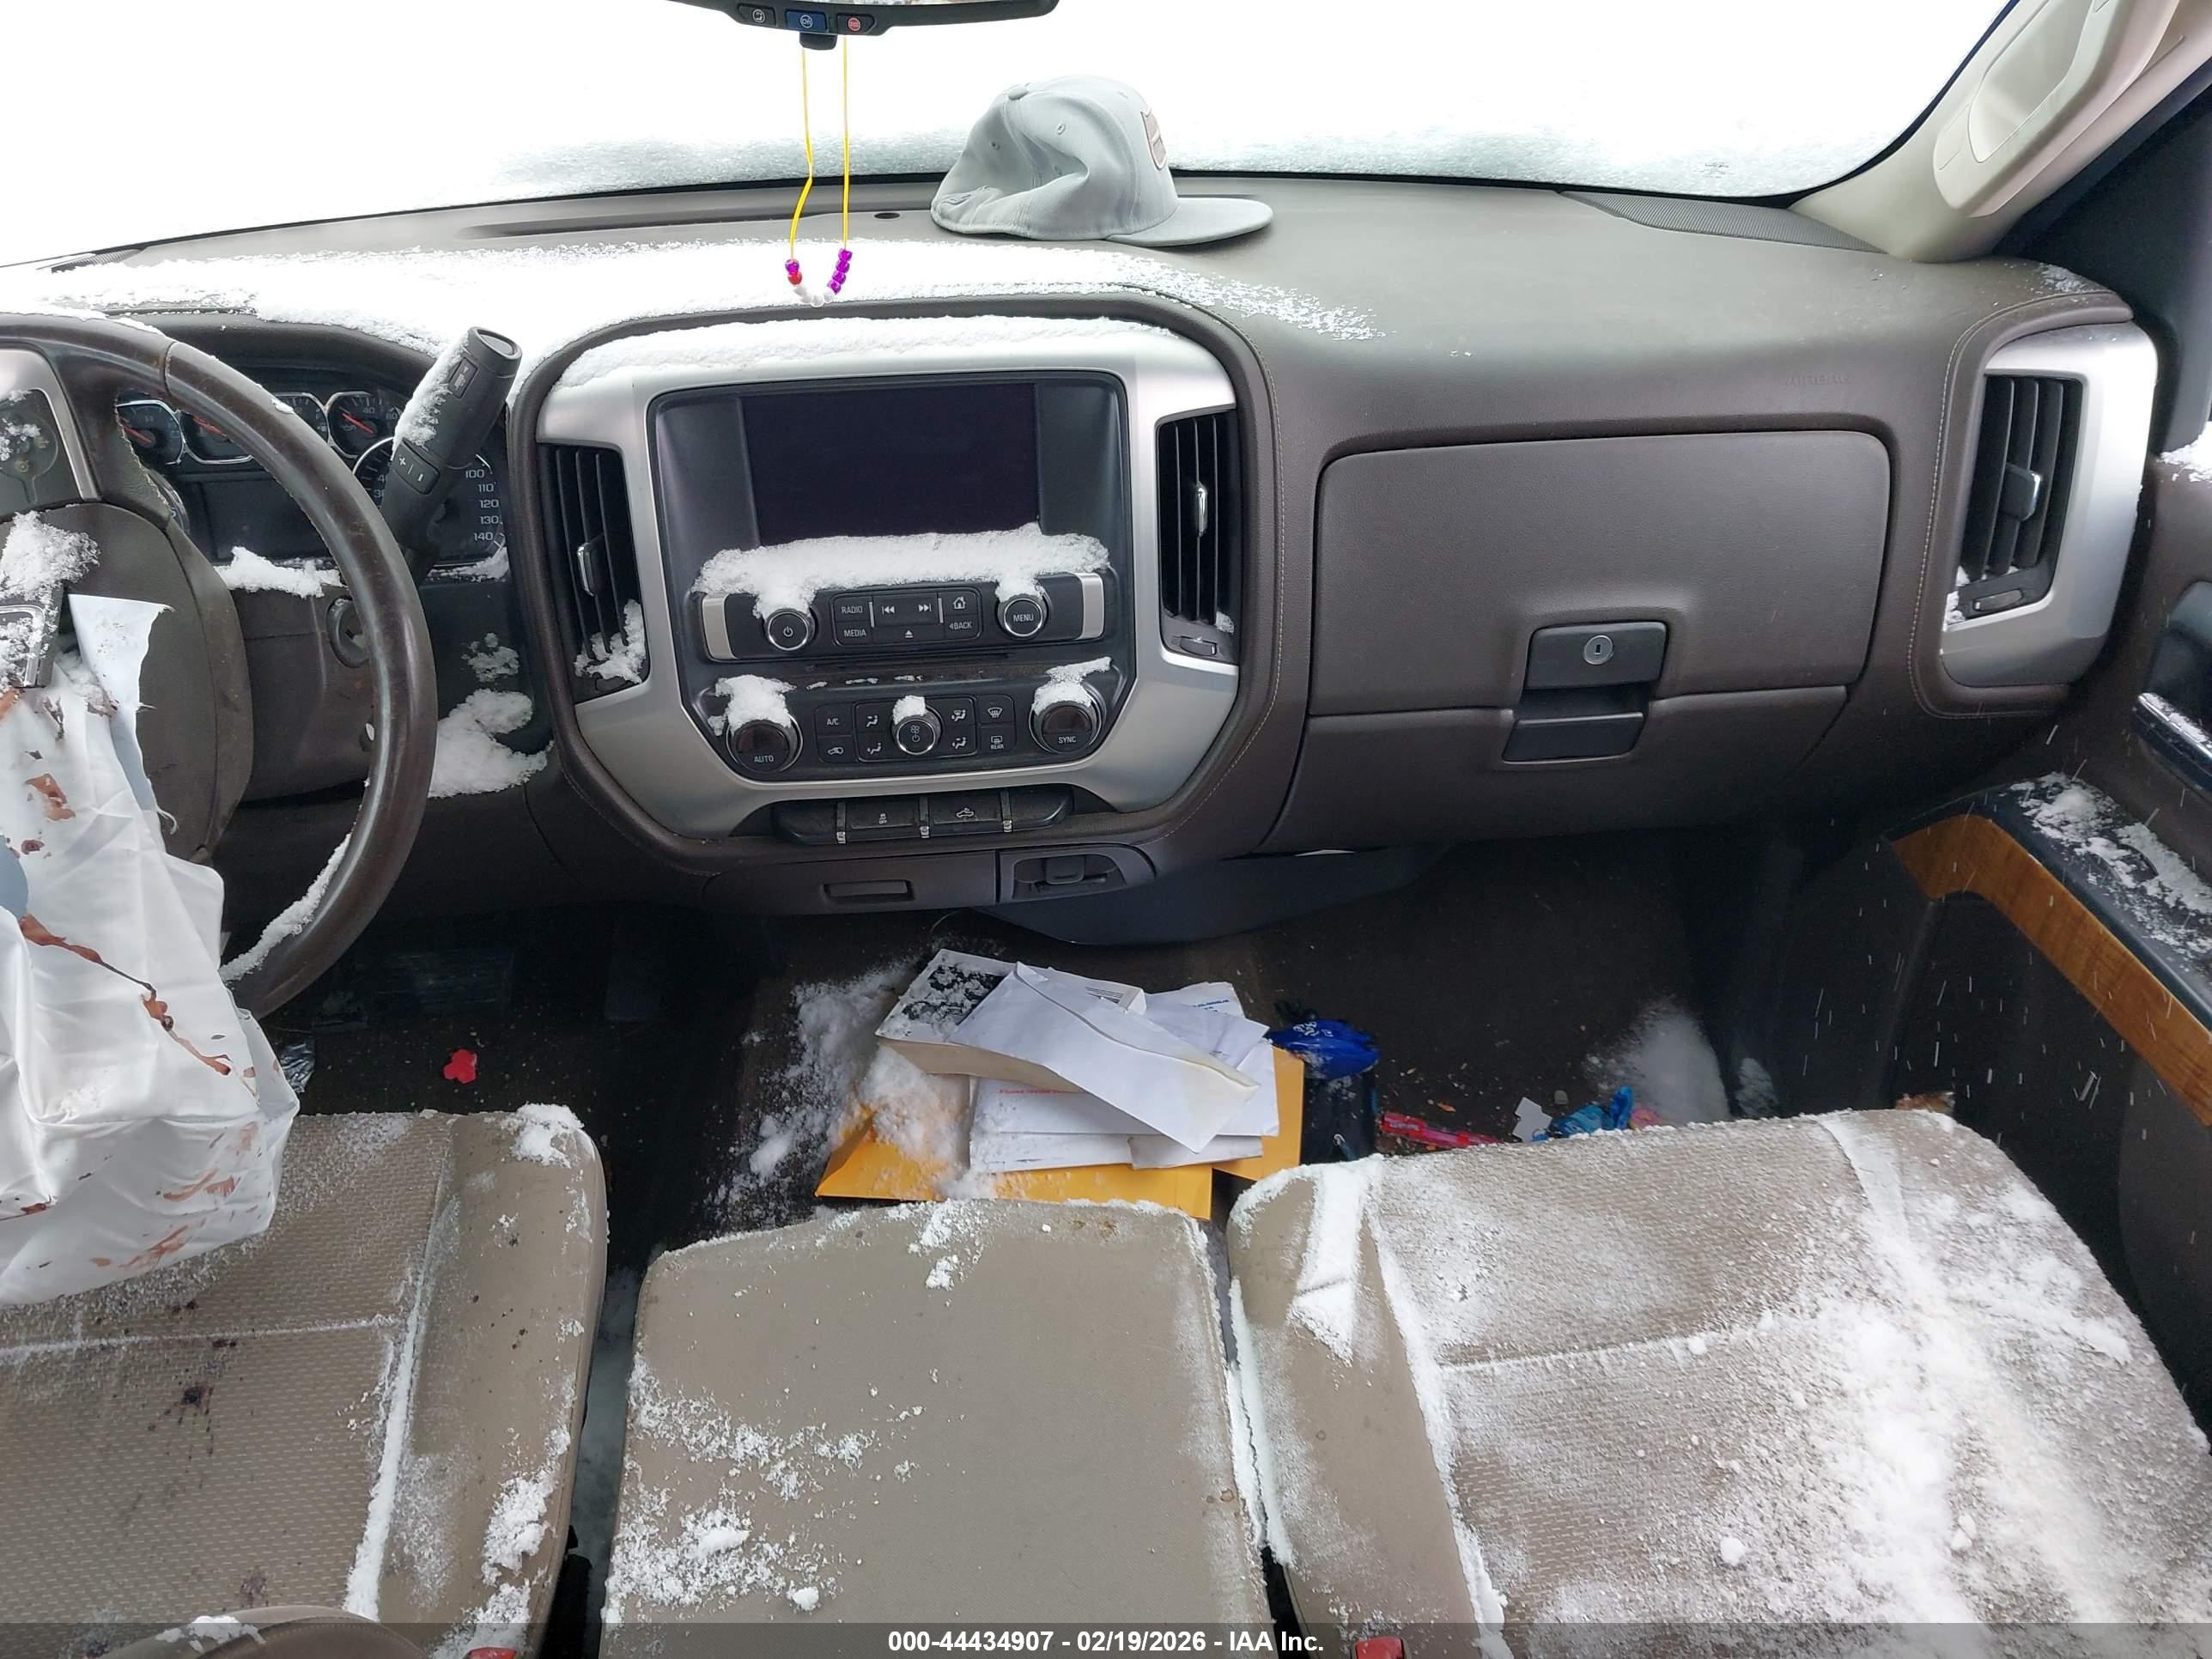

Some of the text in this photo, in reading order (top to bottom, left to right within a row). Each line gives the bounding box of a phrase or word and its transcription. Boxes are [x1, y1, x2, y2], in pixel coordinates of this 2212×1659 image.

[465, 469, 485, 478] 100
[477, 483, 494, 493] 110
[480, 499, 499, 508] 120
[480, 515, 499, 525] 130
[473, 532, 494, 542] 140
[841, 605, 863, 615] RADIO
[1013, 613, 1035, 623] MENU
[954, 621, 973, 630] BACK
[843, 628, 866, 638] MEDIA
[826, 717, 840, 726] A/C
[1057, 736, 1077, 744] SYNC
[753, 754, 775, 763] AUTO
